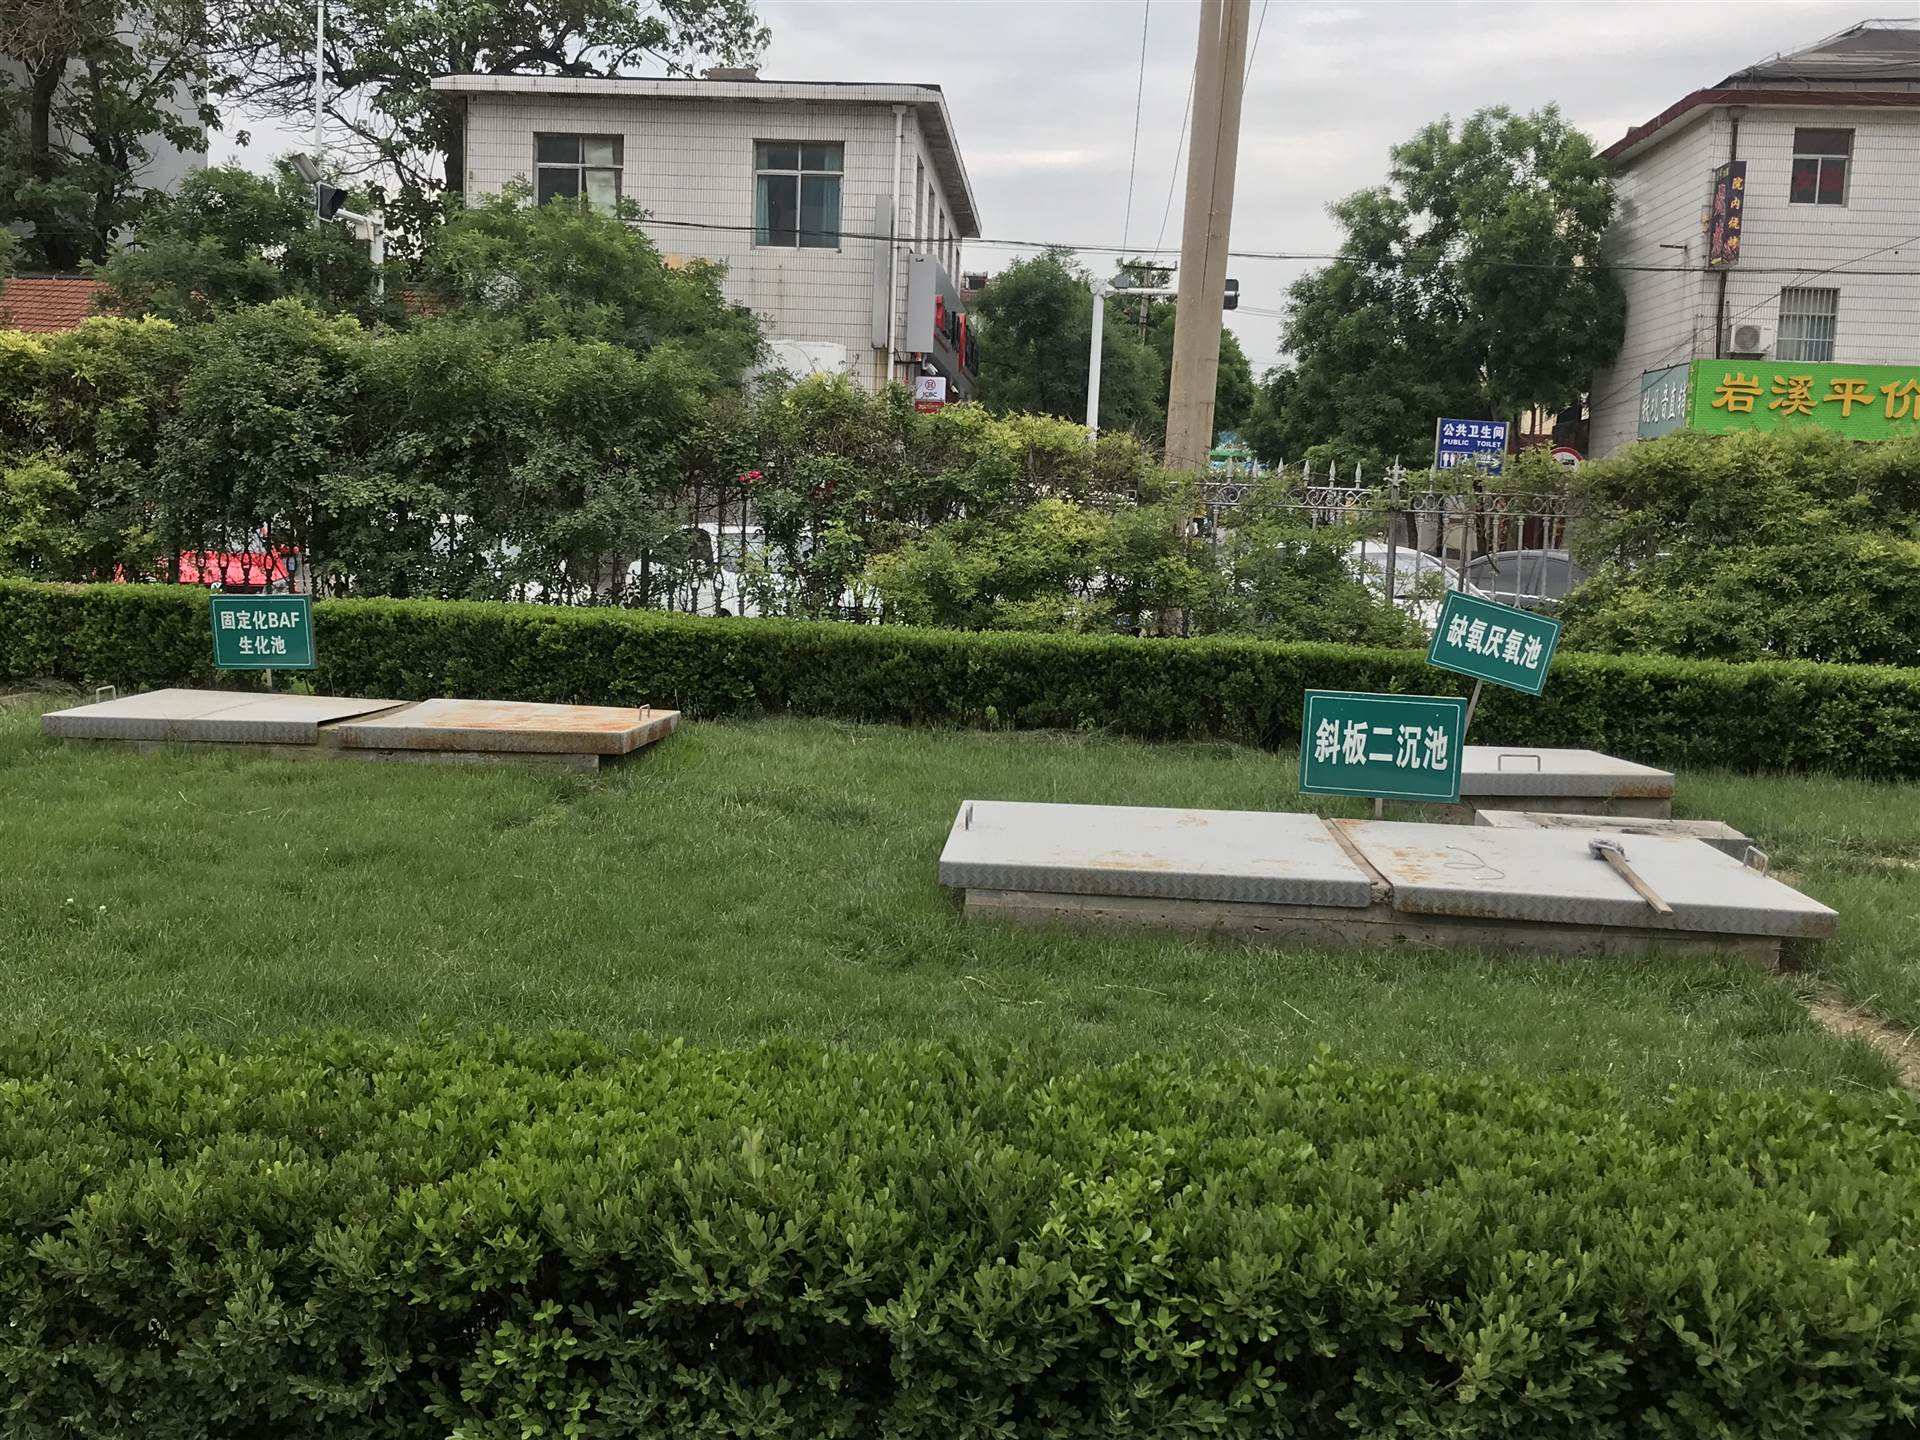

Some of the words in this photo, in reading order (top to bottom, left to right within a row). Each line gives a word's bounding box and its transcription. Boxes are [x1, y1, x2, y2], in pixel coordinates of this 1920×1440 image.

[1711, 372, 1920, 421] 岩溪平价
[1443, 423, 1504, 439] 公共卫生间
[1443, 438, 1469, 446] PUBLIC
[1477, 440, 1501, 448] TOILET
[220, 610, 299, 629] 固定化BAF
[239, 635, 286, 654] 生化池
[1446, 613, 1543, 670] 缺氧厌氧池
[1314, 718, 1448, 770] 斜板二沉池
